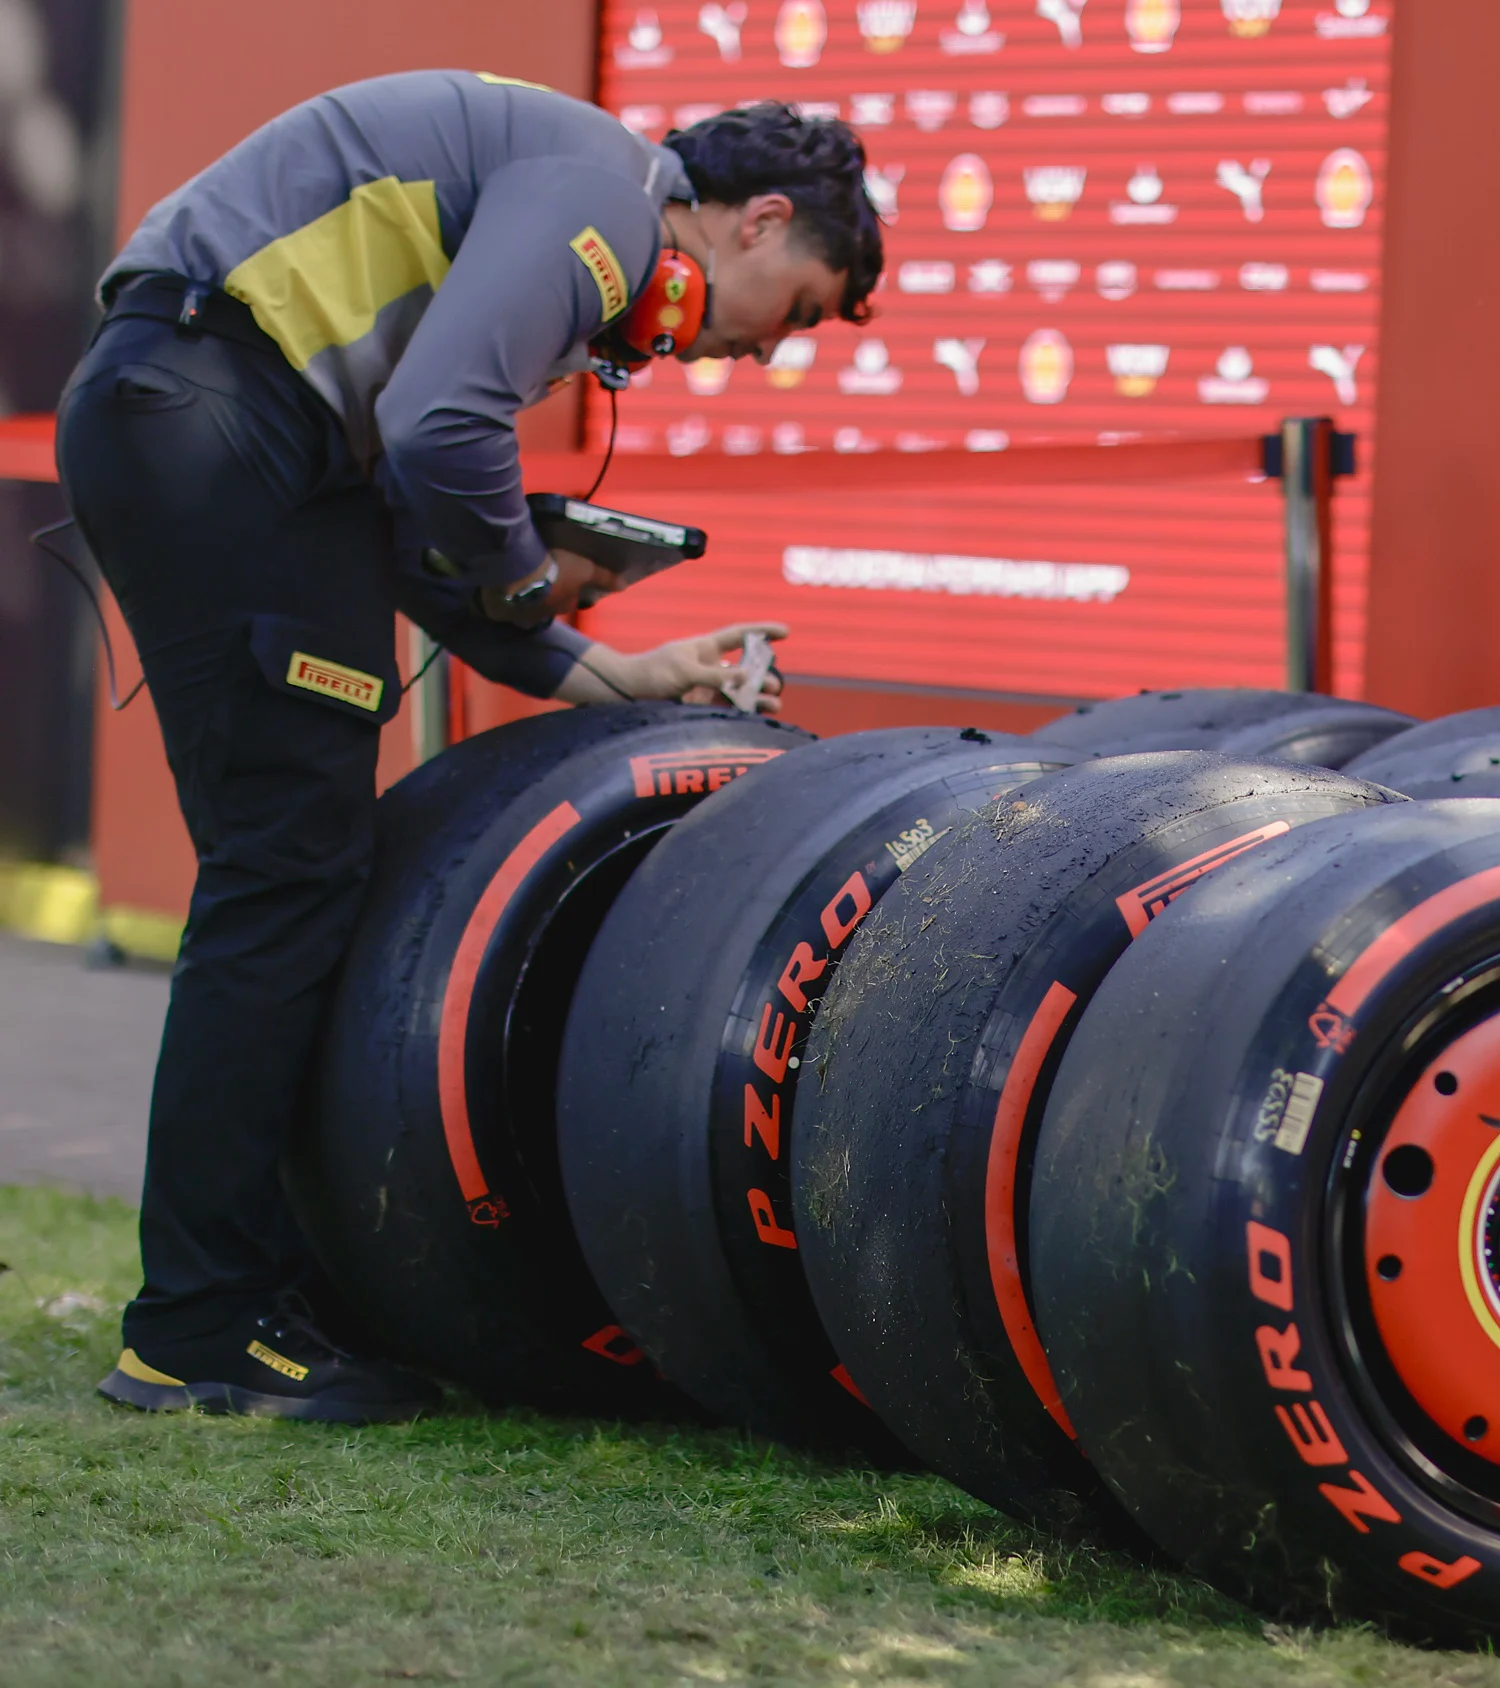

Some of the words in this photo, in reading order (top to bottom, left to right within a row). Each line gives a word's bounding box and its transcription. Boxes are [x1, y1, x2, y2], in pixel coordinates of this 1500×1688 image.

[583, 239, 621, 311] PIRELLI
[298, 661, 373, 702] PIRELLI
[629, 747, 788, 798] PIRE
[743, 871, 872, 1160] ZERO
[747, 1188, 797, 1249] P
[1246, 1219, 1402, 1533] ZERO
[1398, 1549, 1483, 1588] P
